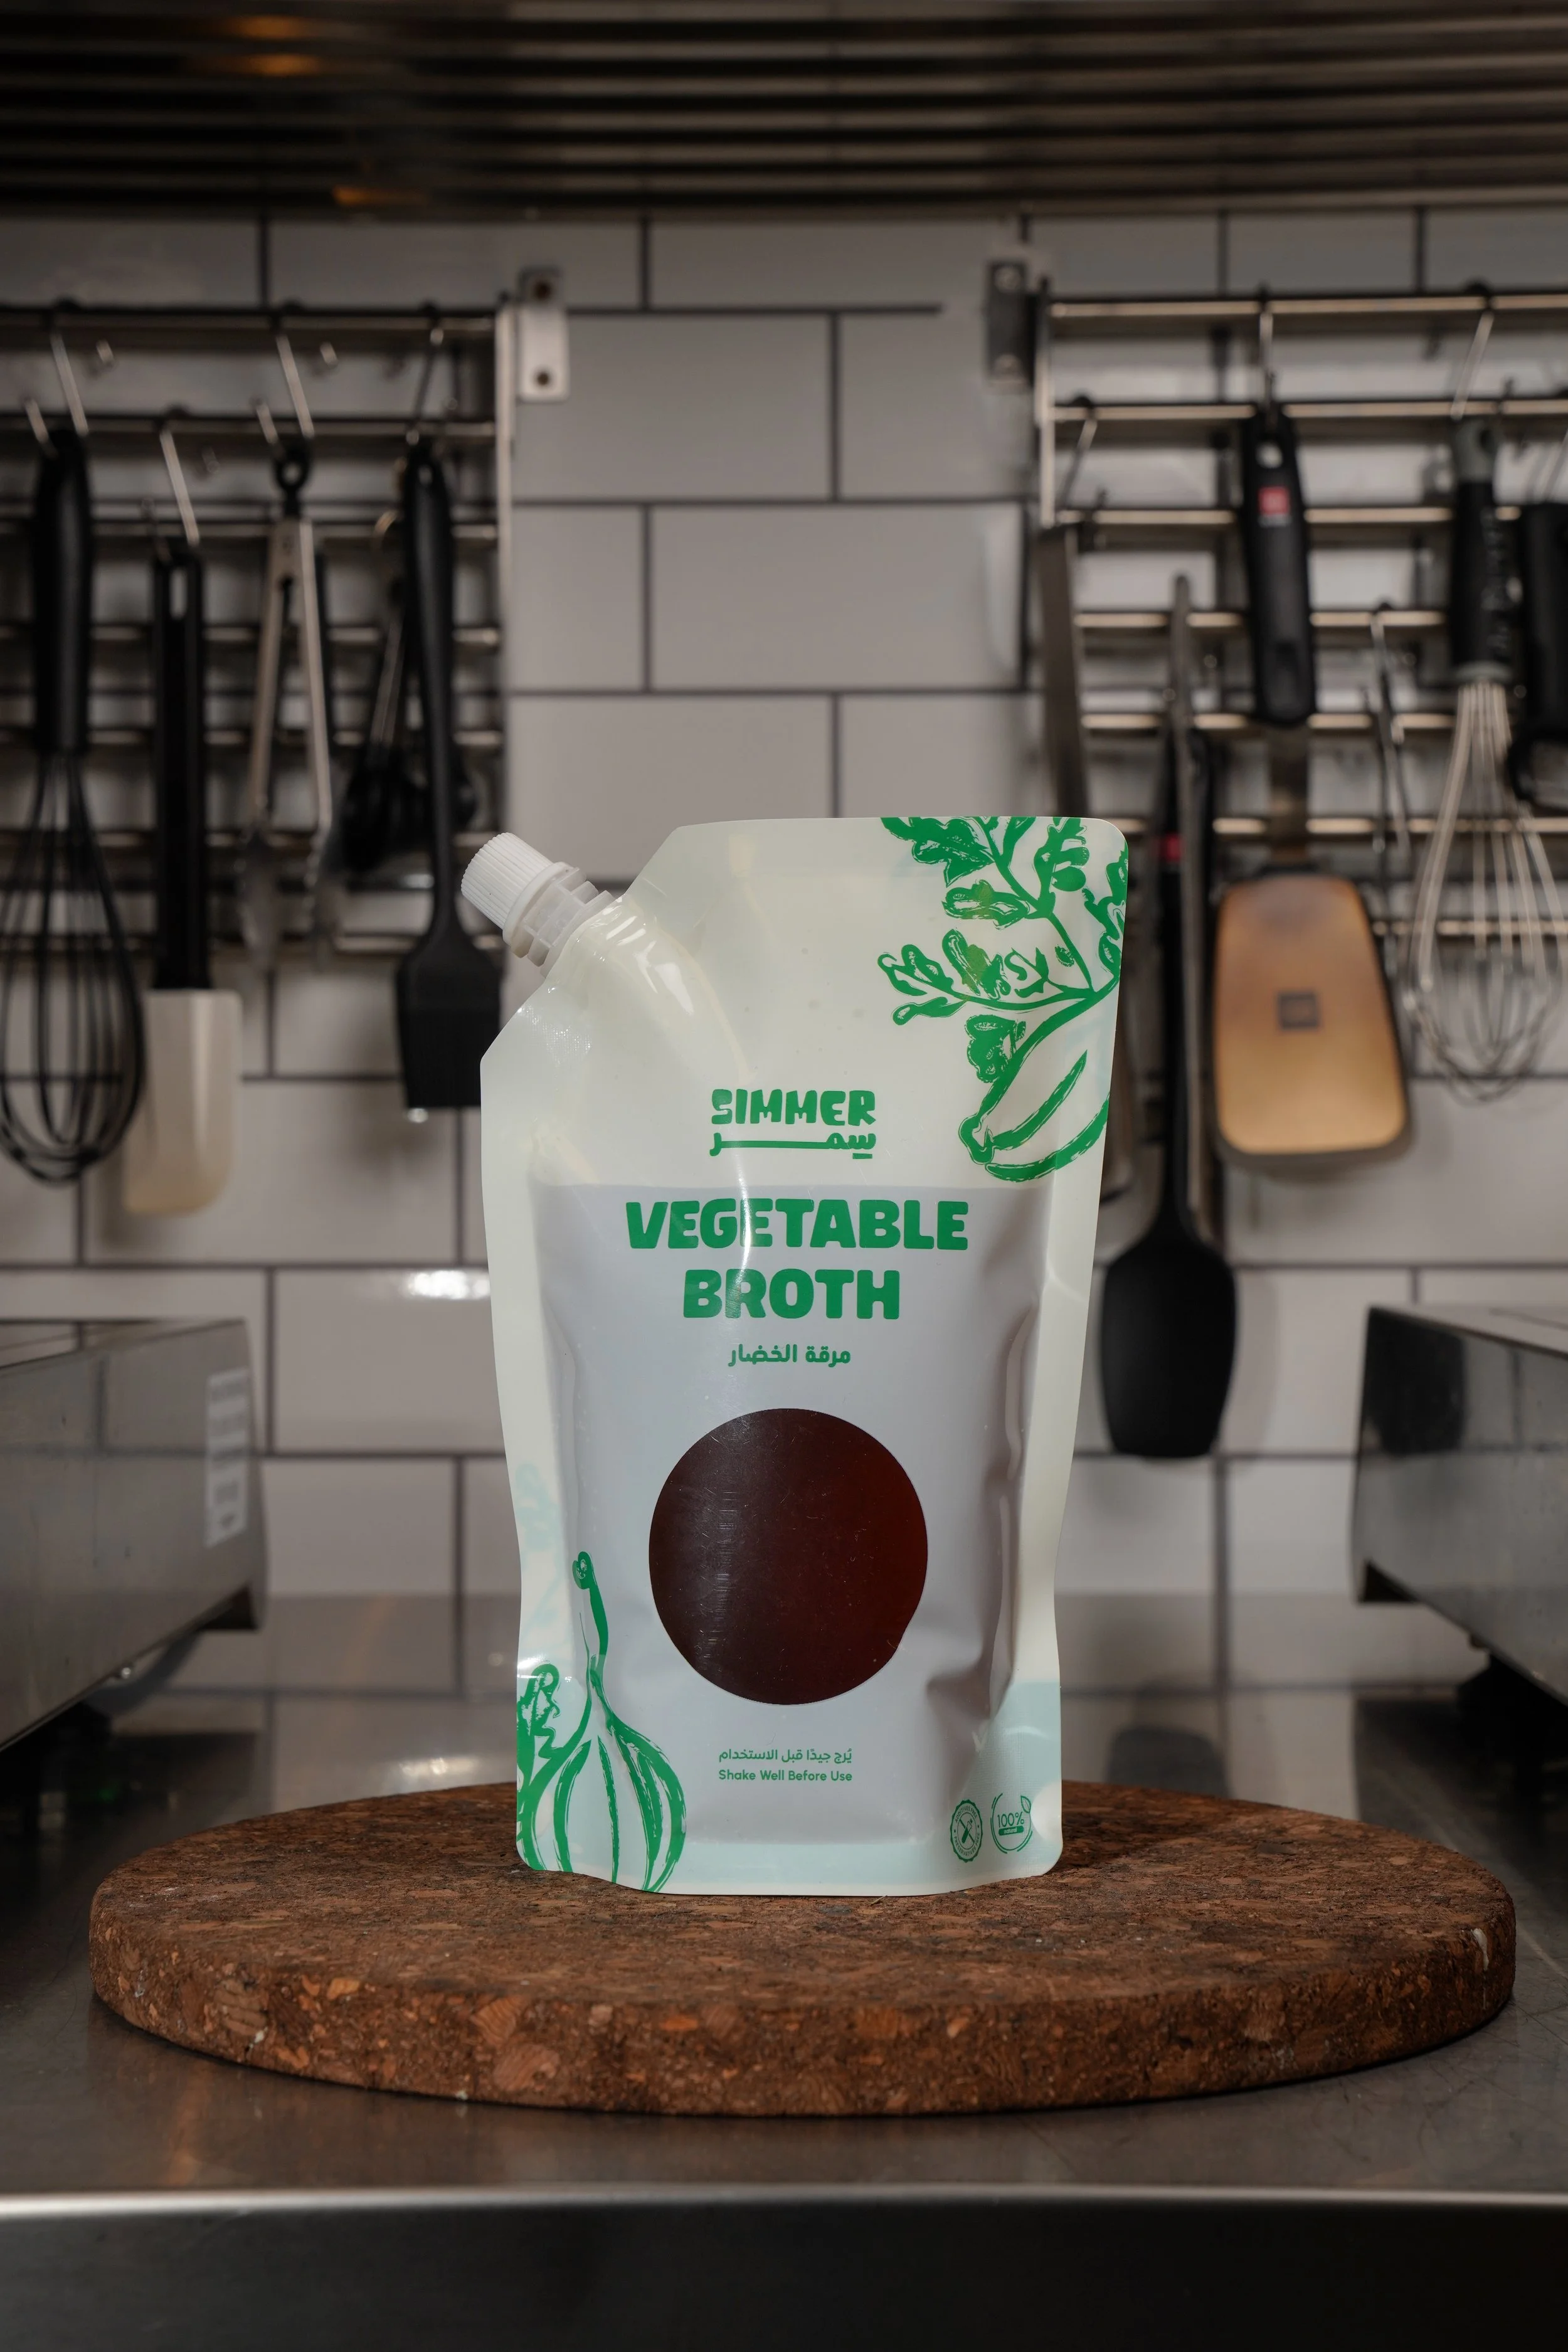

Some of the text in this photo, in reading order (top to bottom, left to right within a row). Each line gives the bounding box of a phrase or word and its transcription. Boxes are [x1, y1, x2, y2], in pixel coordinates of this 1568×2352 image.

[711, 1088, 876, 1126] SIMMER
[625, 1198, 969, 1251] VEGETABLE
[683, 1268, 901, 1320] BROTH
[728, 1344, 851, 1368] مرقة الخضار
[719, 1748, 778, 1762] الاستخدام
[781, 1749, 803, 1763] قبل
[718, 1769, 853, 1782] Shake Well Before Use
[997, 1811, 1025, 1828] 100%
